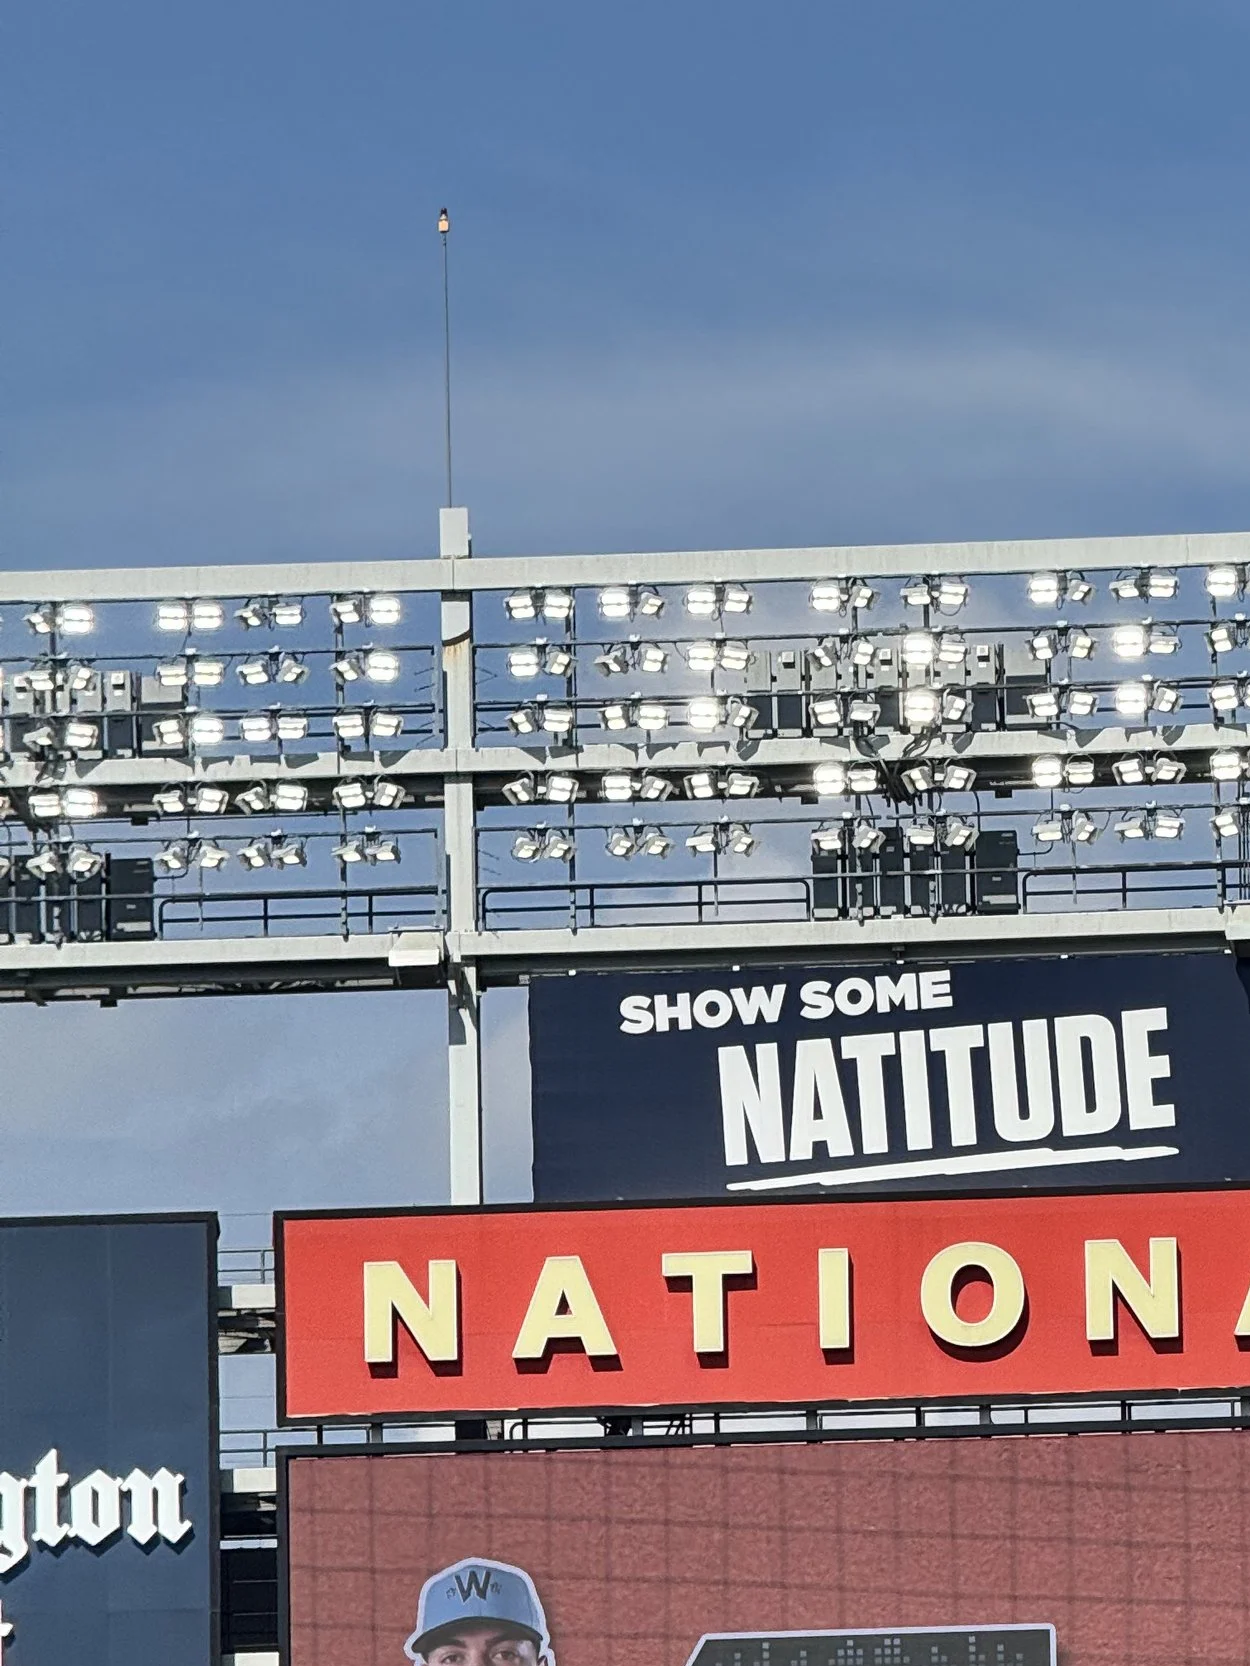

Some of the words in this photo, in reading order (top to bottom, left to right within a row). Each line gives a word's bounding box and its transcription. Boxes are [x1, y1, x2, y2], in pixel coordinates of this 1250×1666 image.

[619, 984, 786, 1034] SHOW
[800, 969, 953, 1020] SOME
[718, 1007, 1176, 1167] NATITUDE
